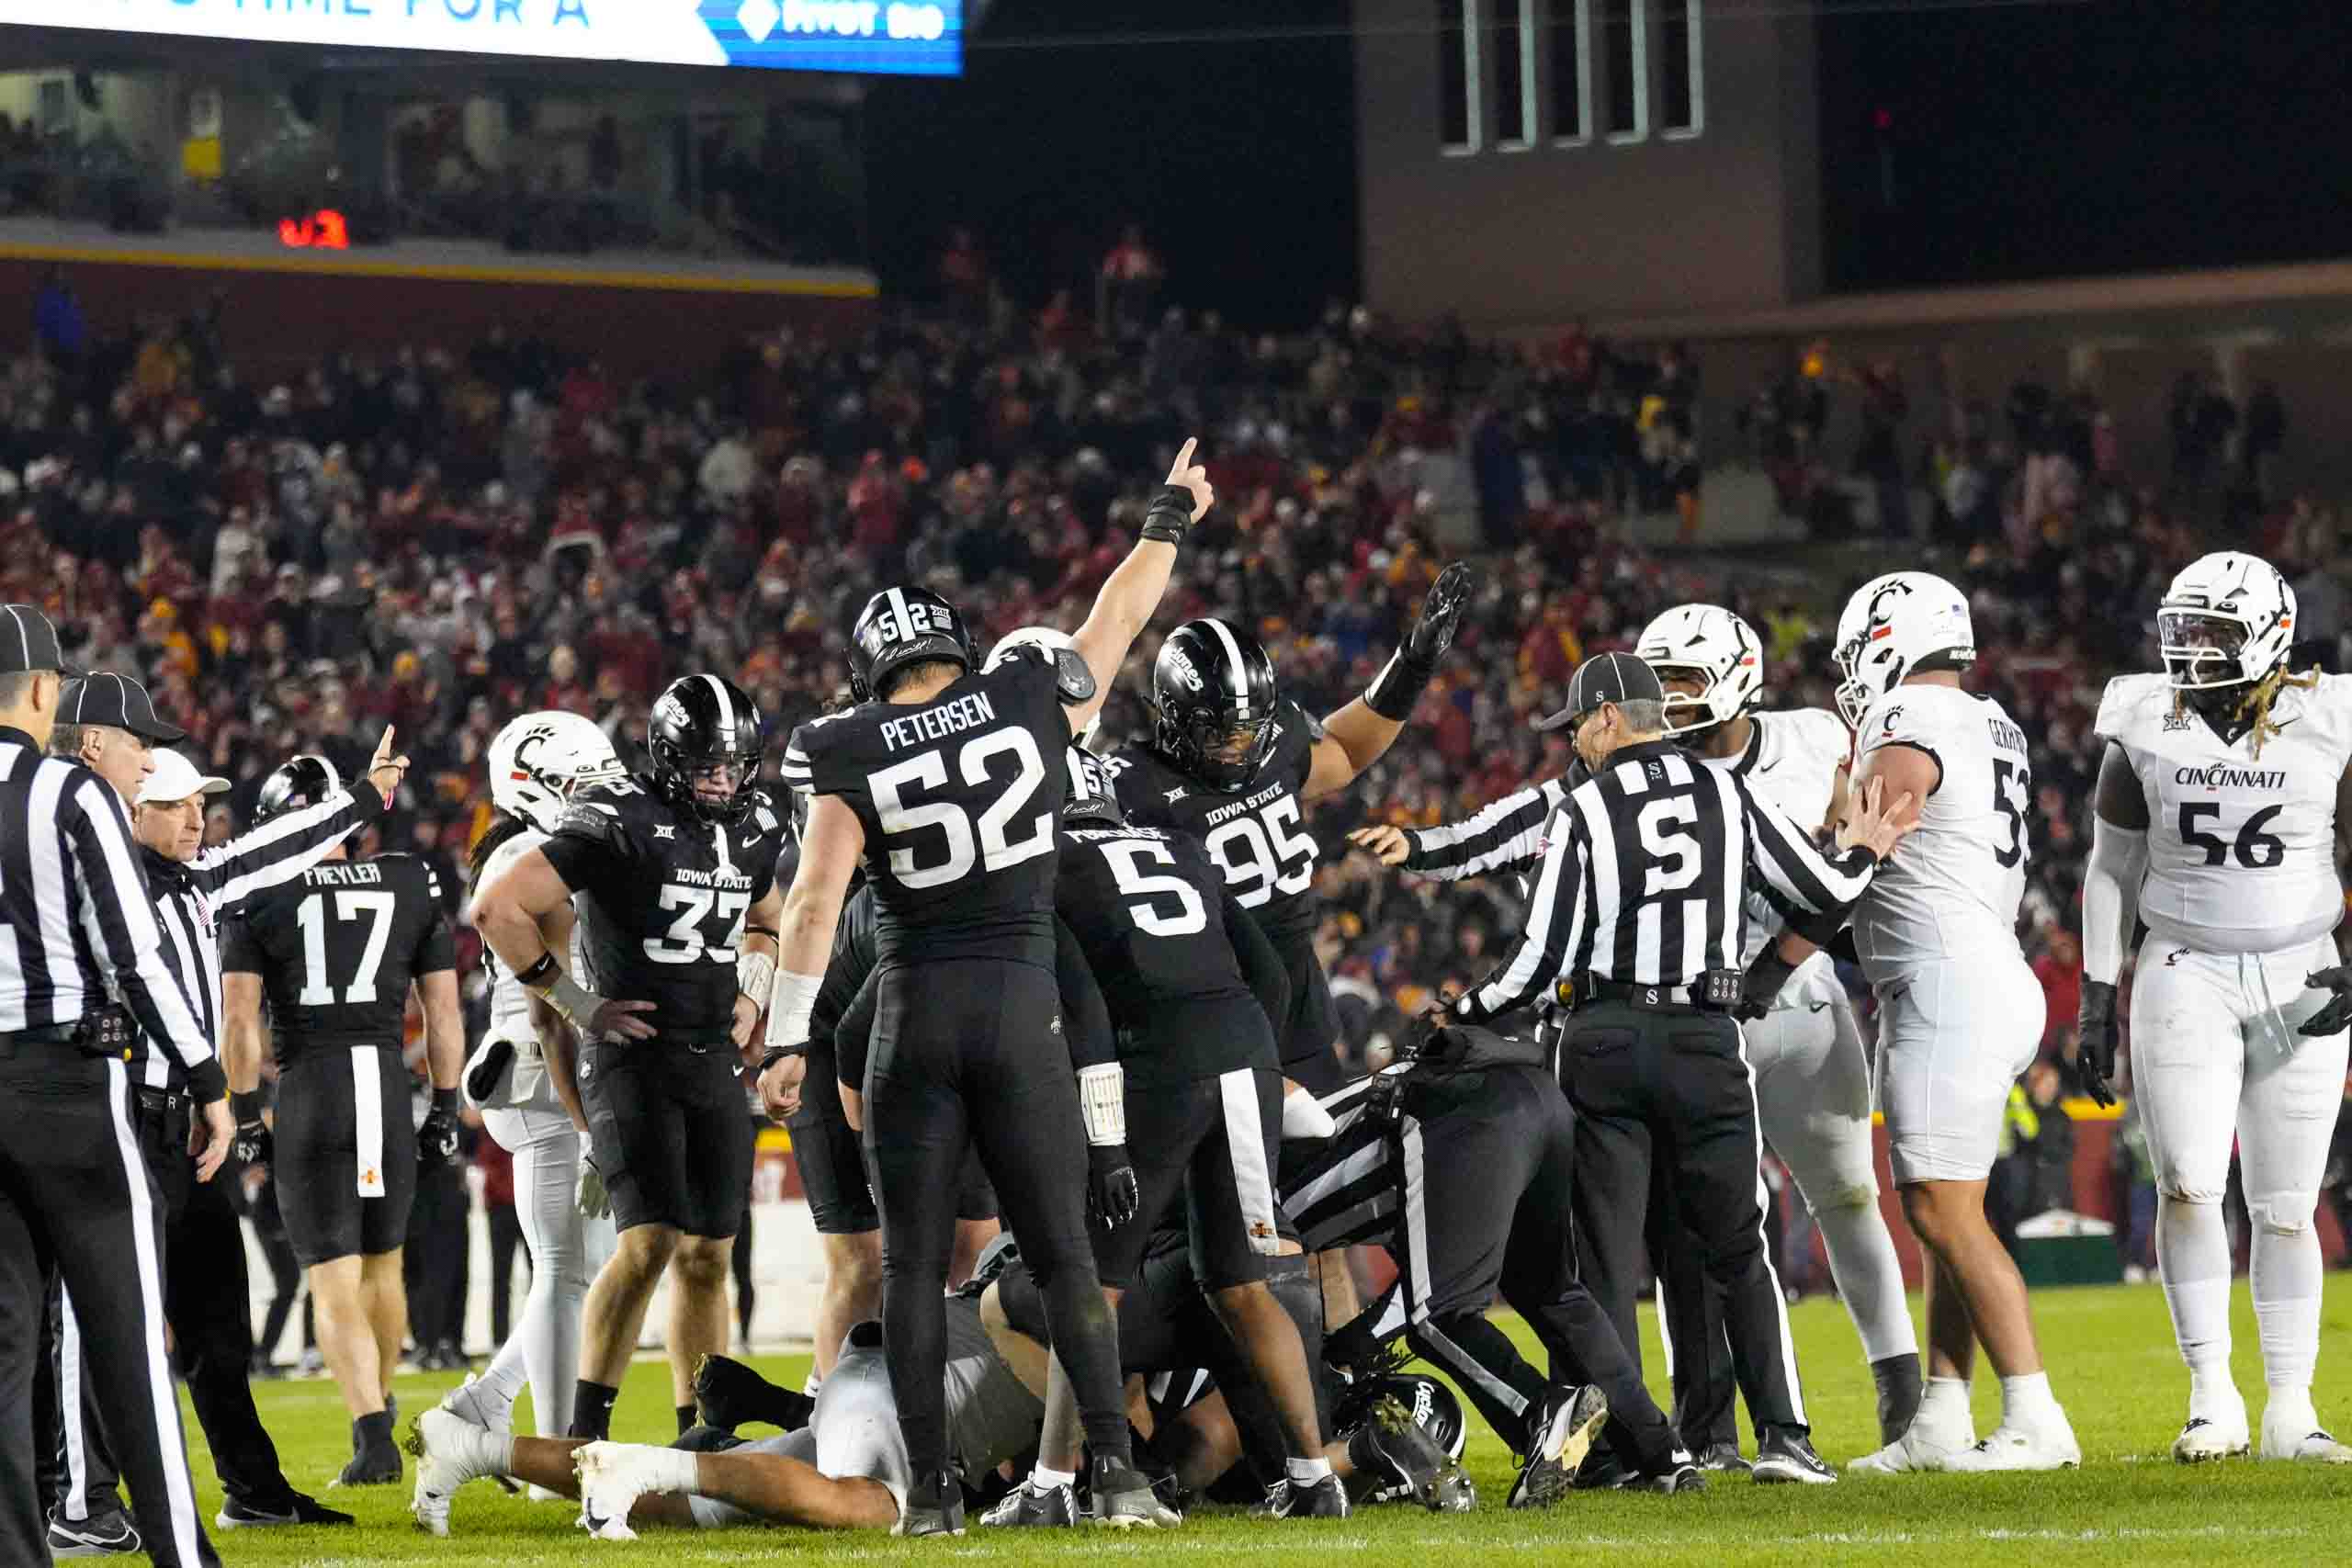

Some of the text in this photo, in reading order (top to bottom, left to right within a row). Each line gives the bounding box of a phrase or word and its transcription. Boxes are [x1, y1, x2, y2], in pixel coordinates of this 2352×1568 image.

[879, 691, 996, 751] PETERSEN
[866, 726, 1055, 889] 52
[1205, 781, 1283, 827] IOWA STATE
[2175, 764, 2287, 790] CINCINNATI
[1204, 794, 1320, 909] 95
[1637, 794, 1702, 897] S
[2178, 801, 2285, 869] 56
[675, 868, 753, 890] IOWA STATE
[1097, 839, 1207, 937] 5
[297, 890, 396, 1006] 17
